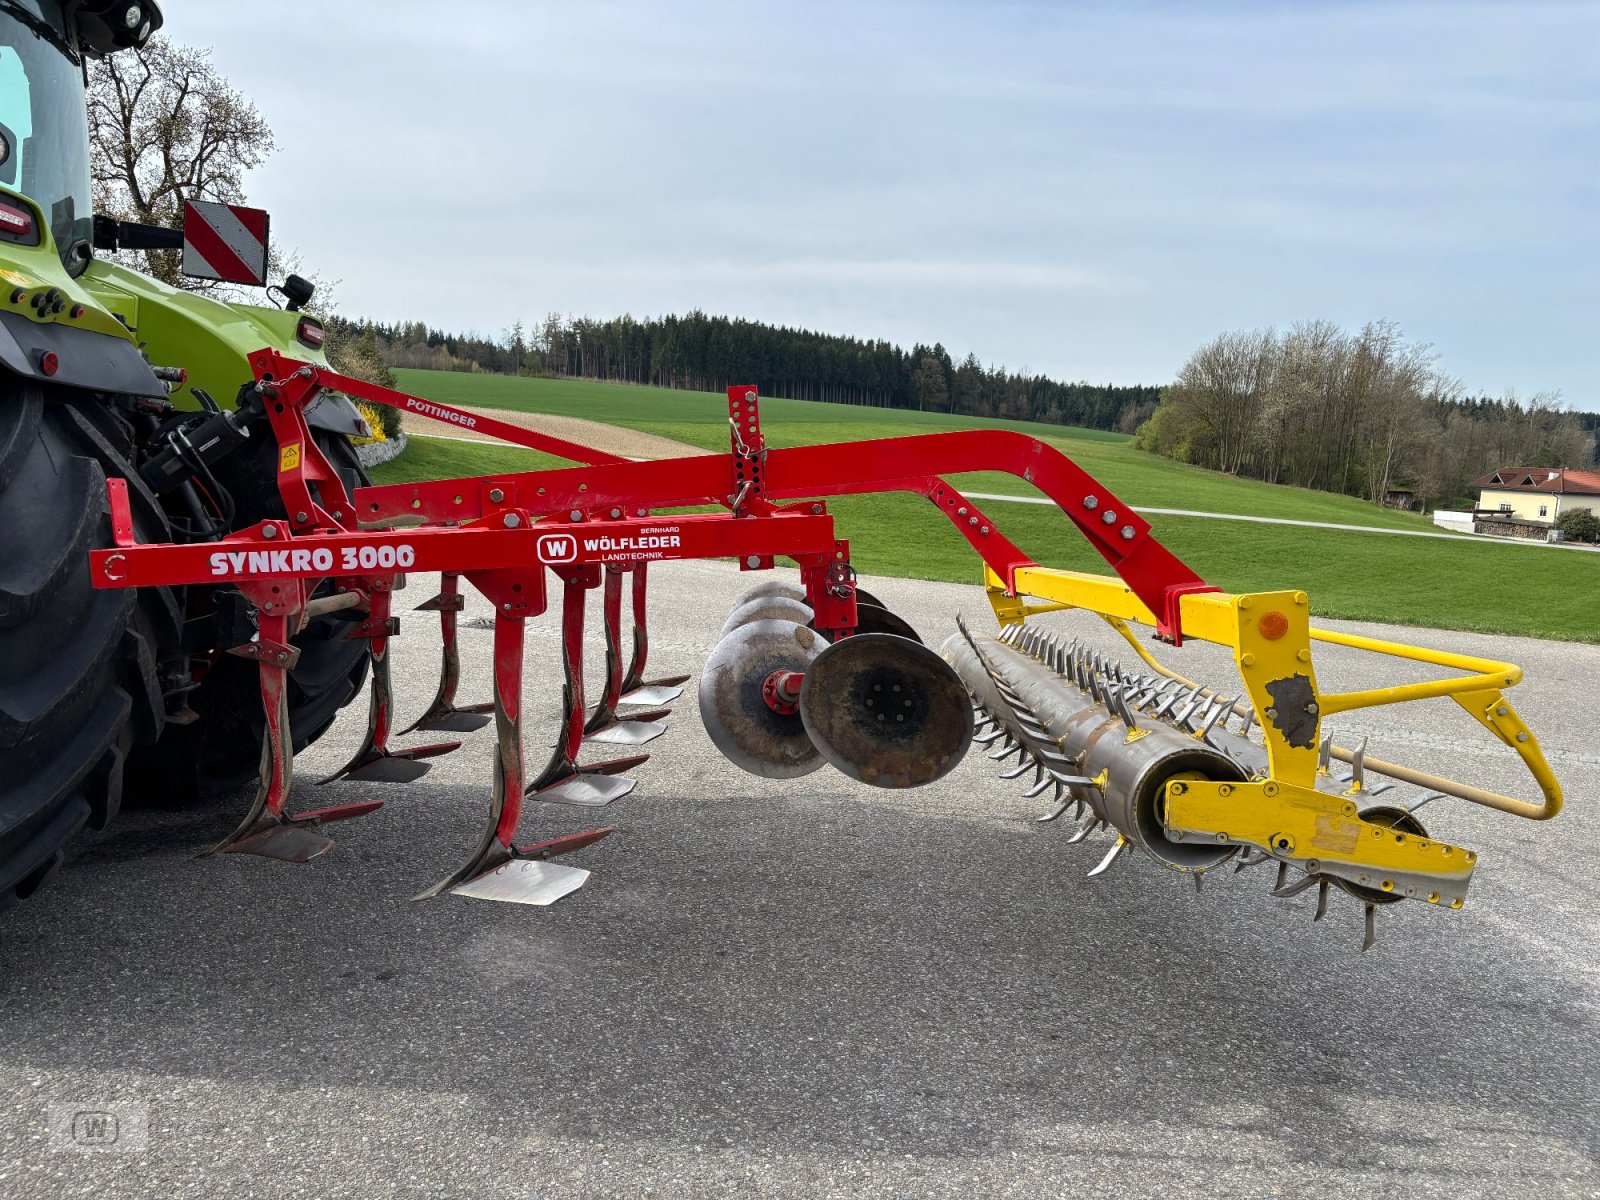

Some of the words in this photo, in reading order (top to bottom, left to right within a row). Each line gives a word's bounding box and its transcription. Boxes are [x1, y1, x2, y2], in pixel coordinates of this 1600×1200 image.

[406, 398, 477, 427] PÖTTINGER
[640, 526, 680, 534] BERNHARD
[546, 541, 567, 557] W
[583, 535, 681, 551] WÖLFLEDER
[210, 548, 333, 575] SYNKRO
[341, 545, 415, 570] 3000
[602, 551, 664, 561] LANDTECHNIK
